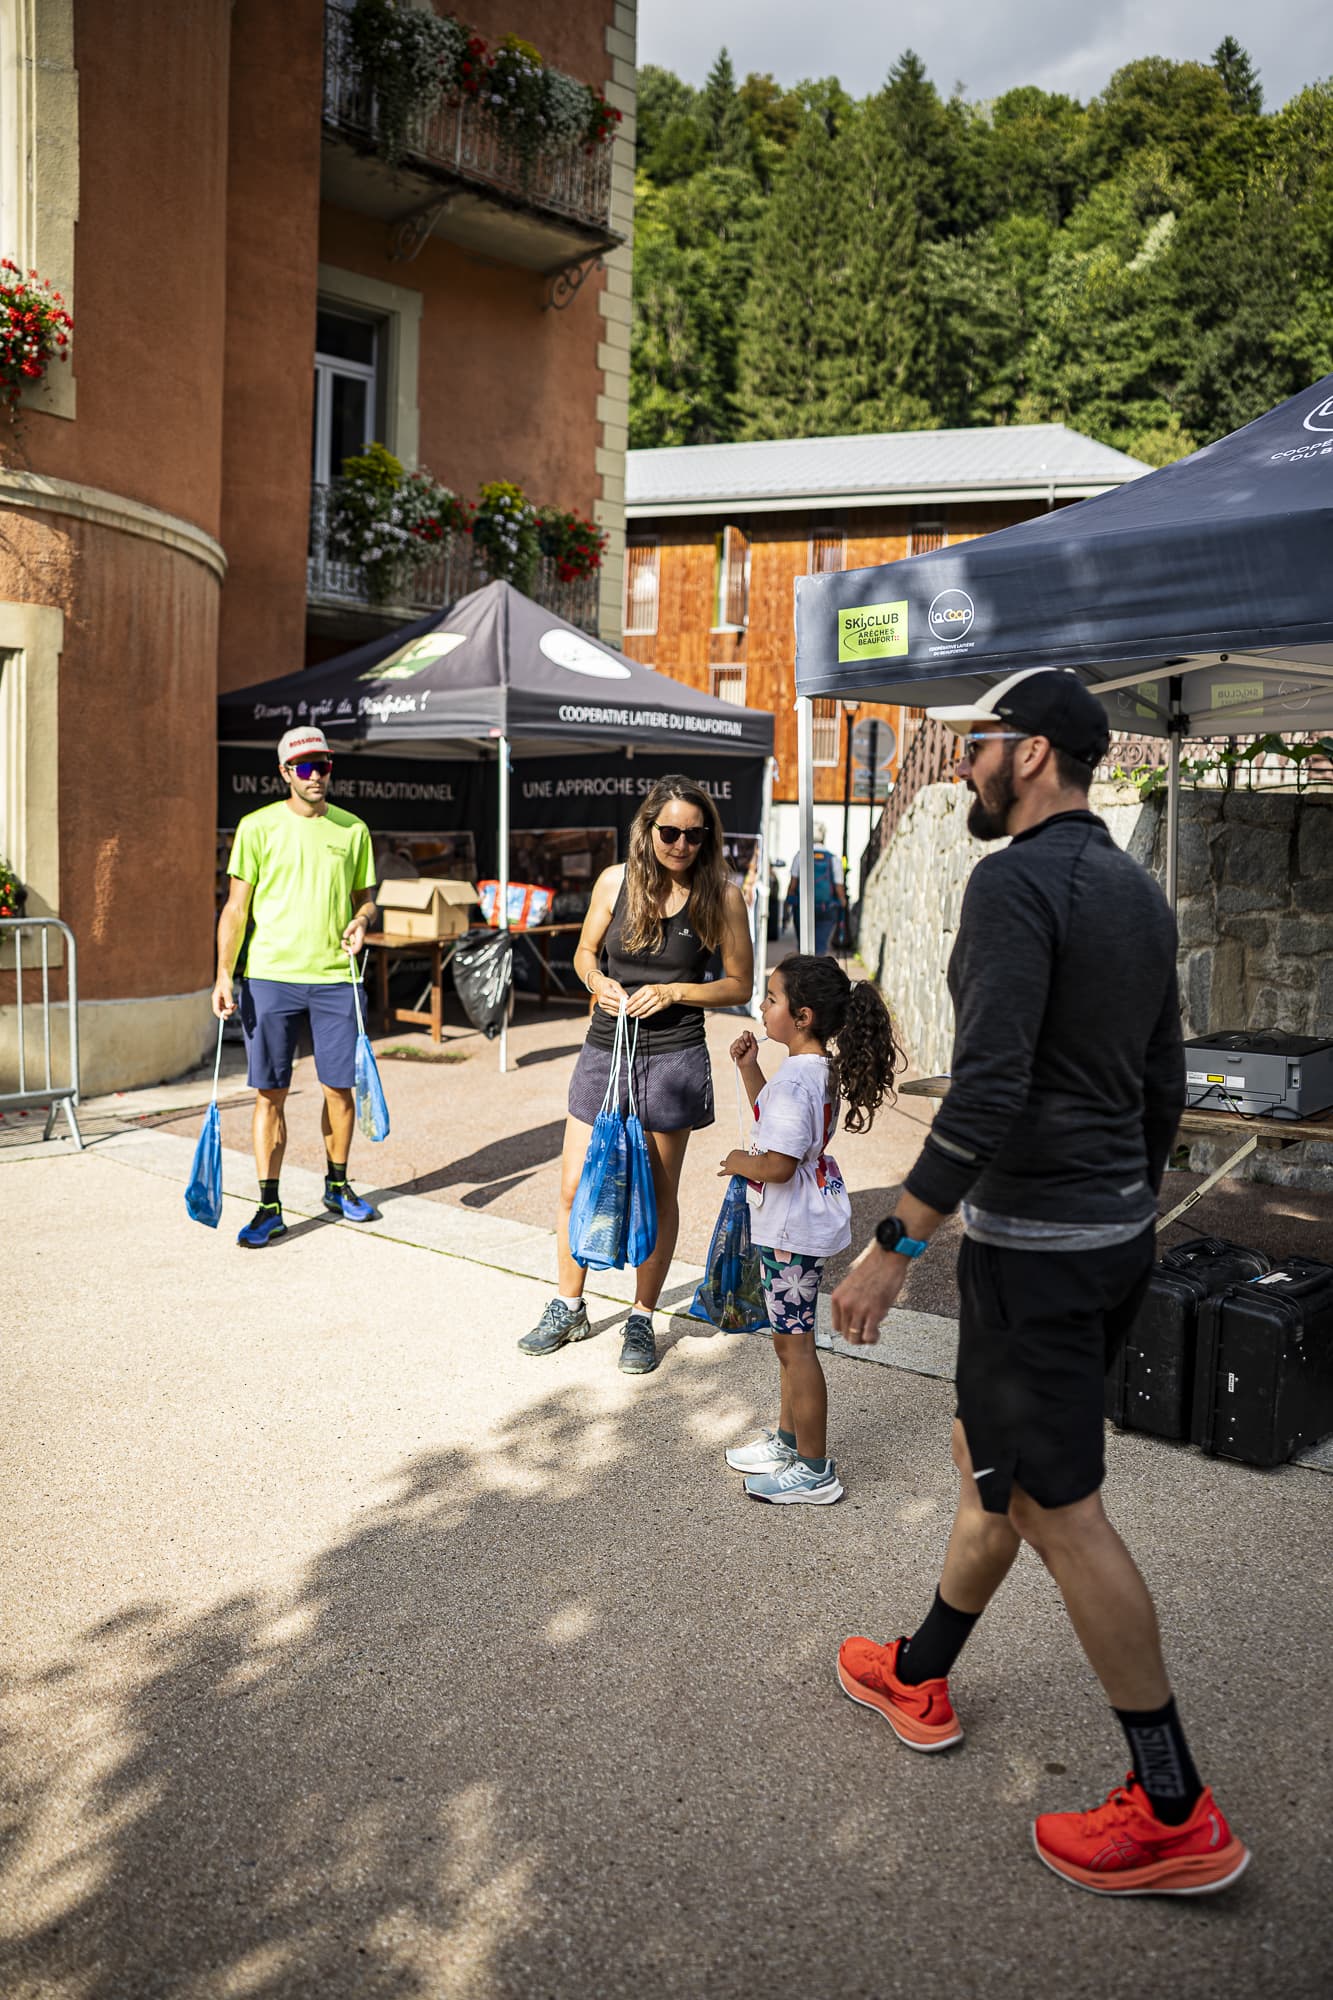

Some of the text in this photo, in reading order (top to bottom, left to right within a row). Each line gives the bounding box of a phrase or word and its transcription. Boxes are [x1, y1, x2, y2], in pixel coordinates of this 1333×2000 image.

[1289, 451, 1318, 462] DU
[867, 612, 899, 627] CLUB
[858, 635, 894, 646] BEAUFORT
[669, 715, 685, 730] DU
[684, 716, 742, 736] BEAUFORTAIN
[232, 775, 257, 794] UN
[358, 780, 454, 801] TRADITIONNEL
[522, 779, 553, 798] UNE
[555, 777, 634, 797] APPROCHE
